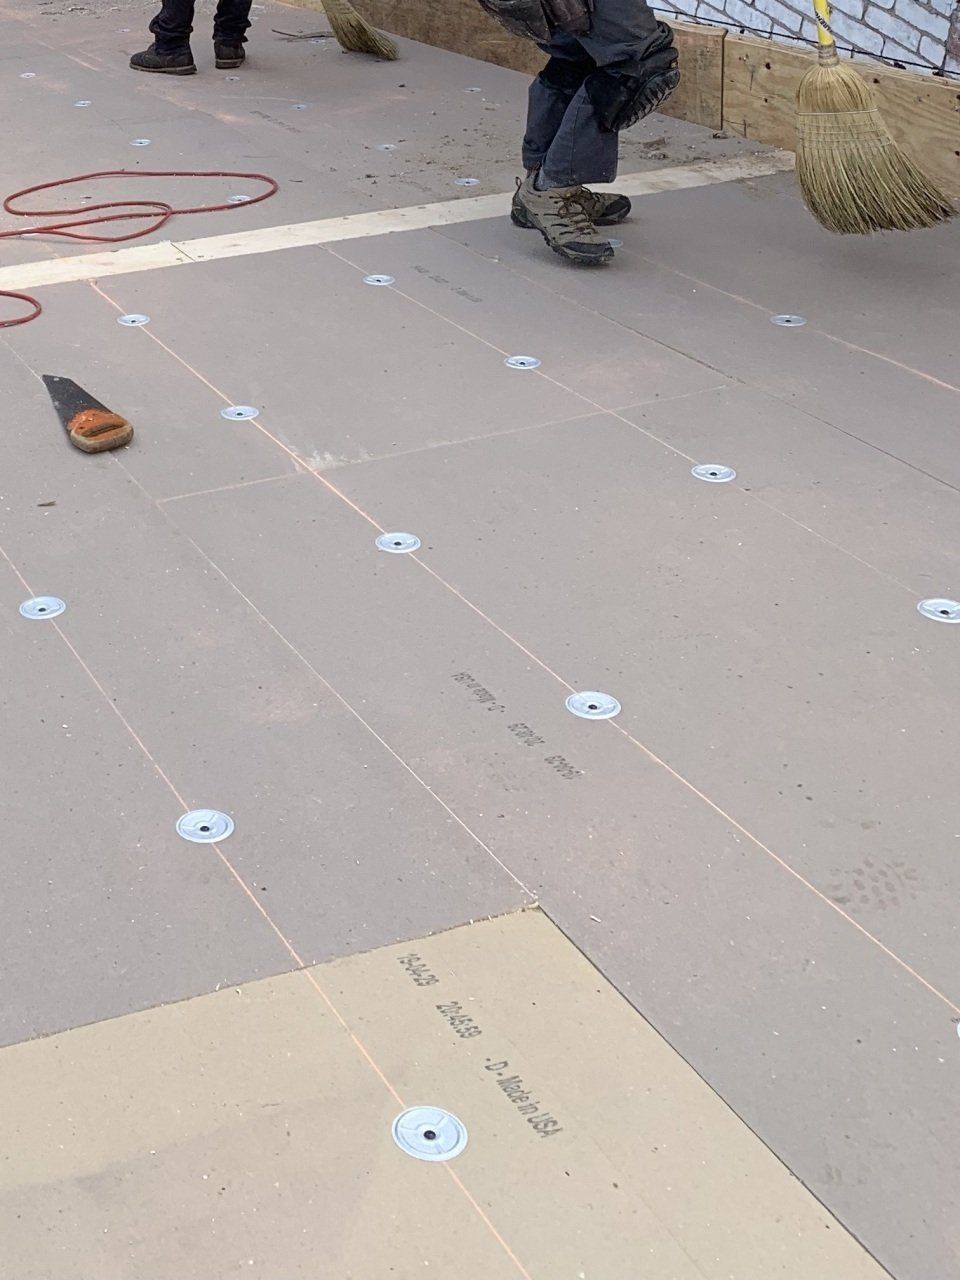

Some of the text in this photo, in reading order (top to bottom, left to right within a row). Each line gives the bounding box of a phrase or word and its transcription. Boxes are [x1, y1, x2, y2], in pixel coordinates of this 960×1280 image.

[397, 953, 439, 987] 19-04-29
[496, 1075, 530, 1104] Made
[517, 1100, 541, 1116] in
[526, 1112, 564, 1138] USA
